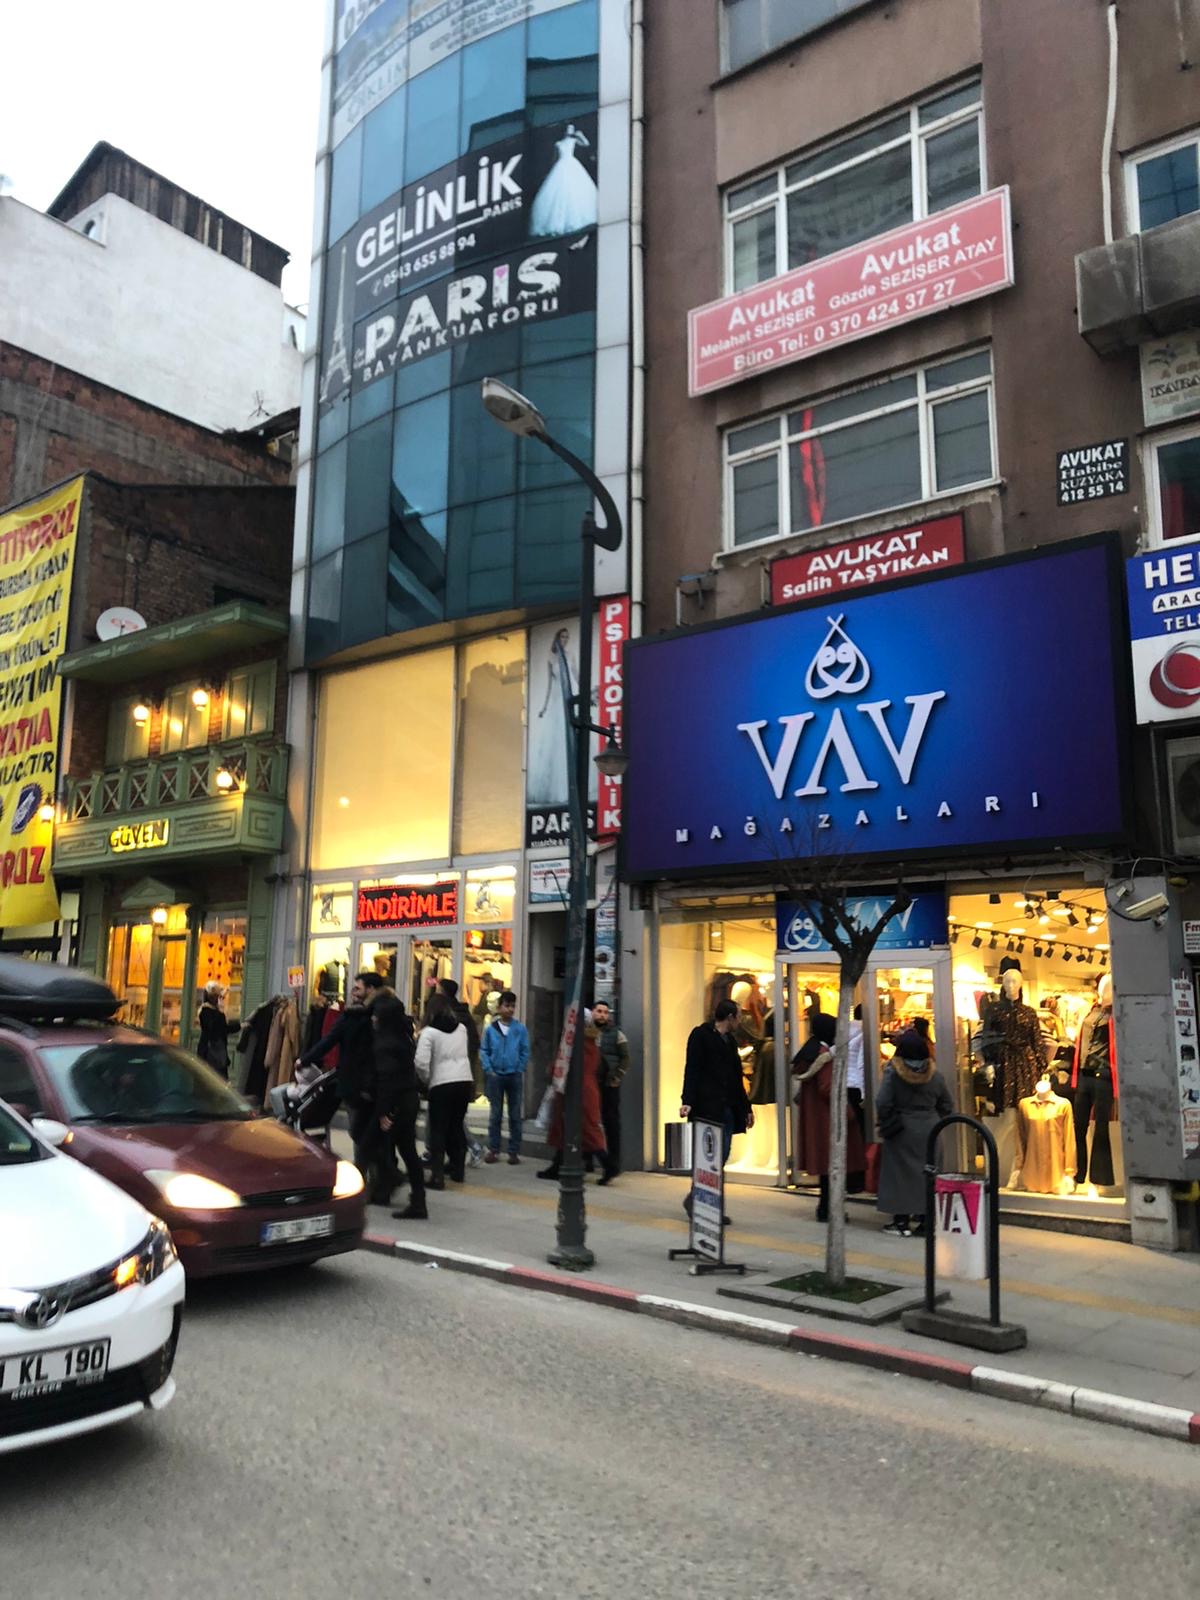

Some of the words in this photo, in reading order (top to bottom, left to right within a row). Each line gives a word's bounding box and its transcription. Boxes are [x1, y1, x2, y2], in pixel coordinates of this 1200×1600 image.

[355, 153, 524, 269] GELİNLİK
[413, 251, 437, 273] 655
[438, 241, 455, 260] 88
[457, 232, 476, 252] 94
[860, 221, 961, 281] Avukat
[829, 285, 876, 310] Gözde
[880, 254, 951, 291] SEZİŞER
[954, 237, 997, 265] ATAY
[727, 279, 815, 331] Avukat
[733, 347, 774, 371] Büro
[778, 333, 808, 355] Tel:
[814, 325, 824, 342] 0
[830, 313, 862, 336] 370
[866, 300, 900, 323] 424
[905, 291, 926, 311] 37
[934, 277, 956, 301] 27
[1059, 442, 1124, 469] AVUKAT
[1061, 461, 1123, 480] Habibe
[1060, 470, 1124, 491] KUZYAKA
[1088, 484, 1104, 498] 55
[1109, 481, 1124, 493] 14
[782, 575, 832, 598] Salih
[838, 546, 949, 583] TAŞYIKAN
[807, 531, 923, 575] AVUKAT
[1144, 552, 1200, 589] HE
[737, 690, 945, 800] VAV
[531, 807, 595, 835] PARS
[675, 791, 1040, 844] MAĞAZALARI
[20, 1354, 48, 1385] KL
[65, 1343, 105, 1377] 190
